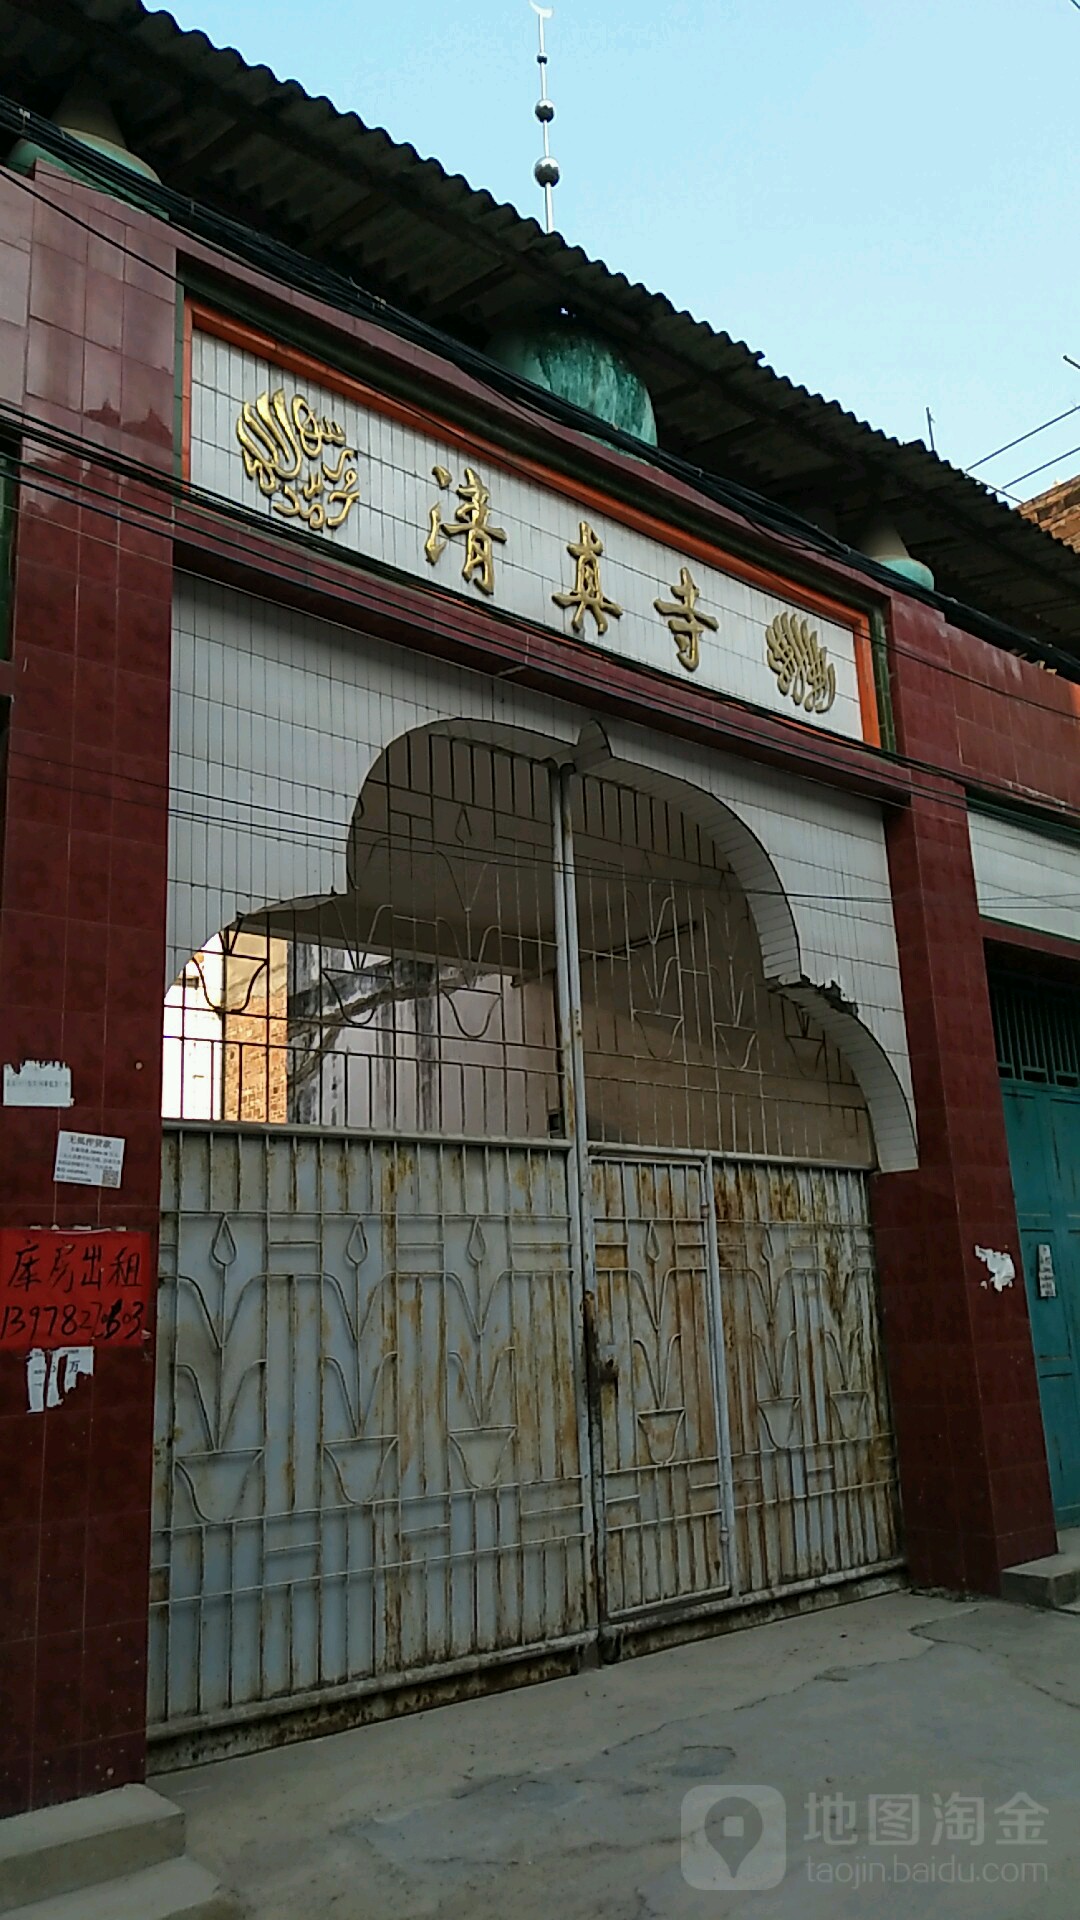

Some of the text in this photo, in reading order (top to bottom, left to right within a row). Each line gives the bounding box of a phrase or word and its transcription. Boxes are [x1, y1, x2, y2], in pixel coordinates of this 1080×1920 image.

[425, 466, 719, 673] 清真寺
[8, 1239, 142, 1293] 库房出租
